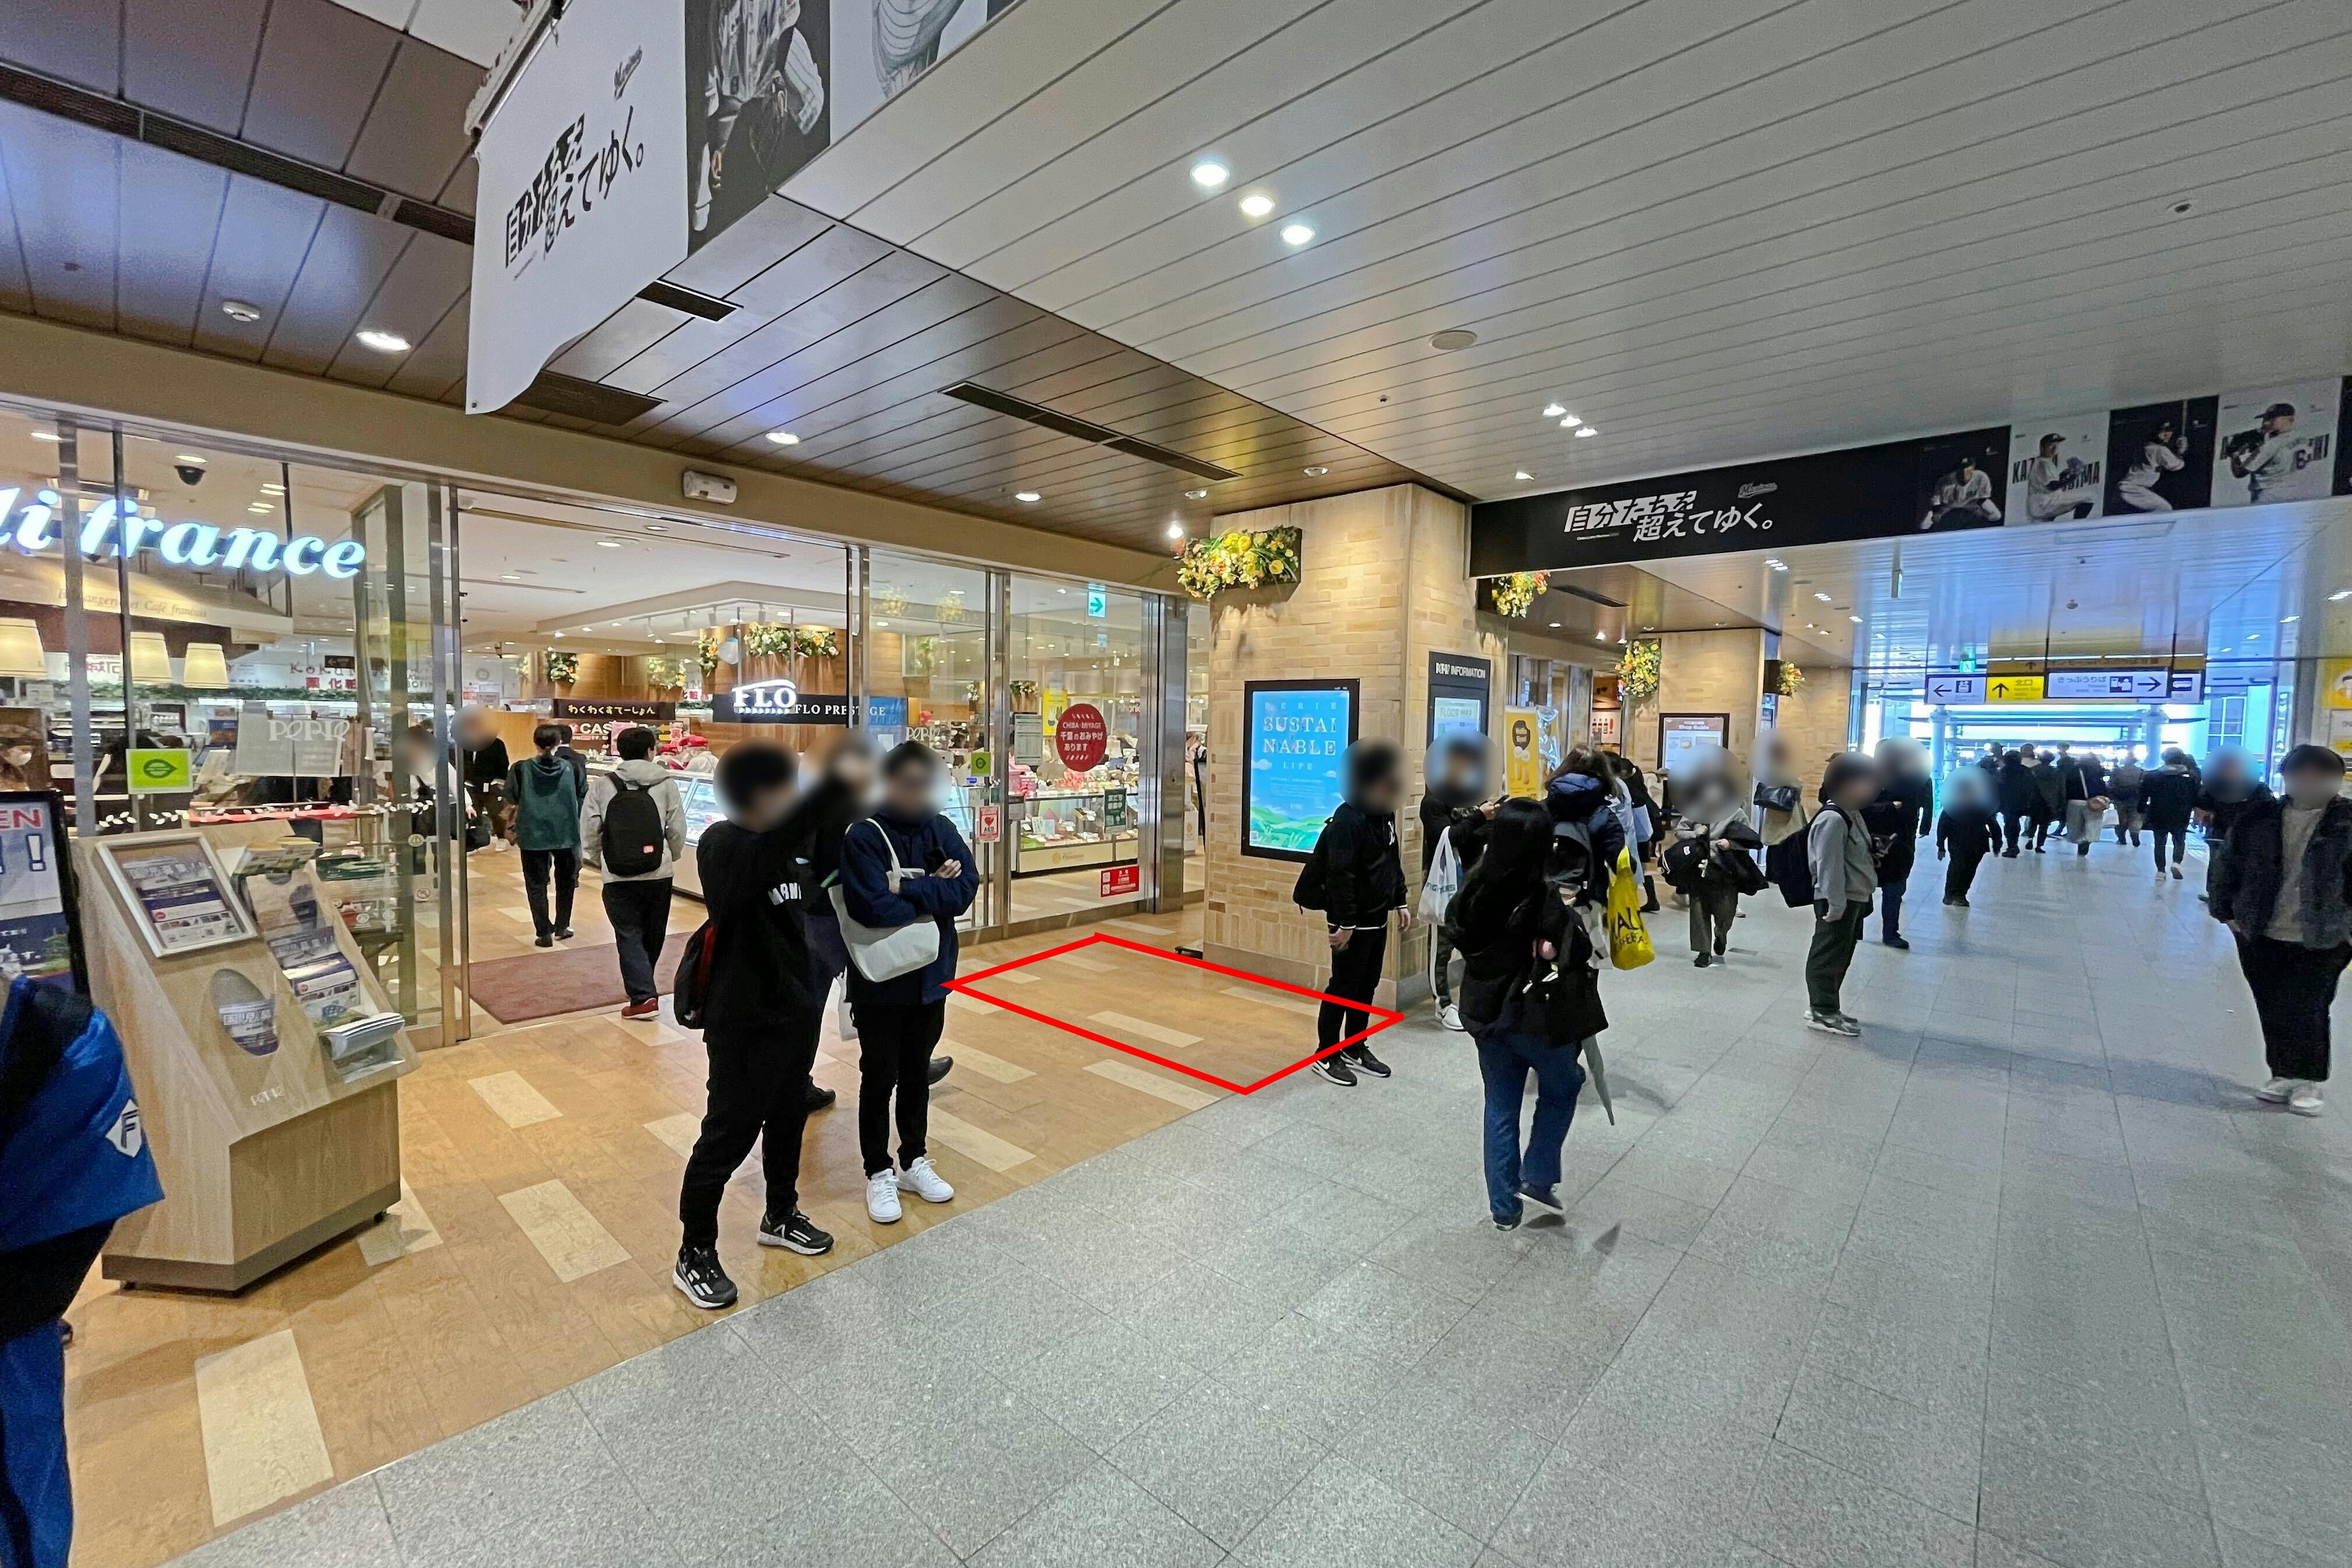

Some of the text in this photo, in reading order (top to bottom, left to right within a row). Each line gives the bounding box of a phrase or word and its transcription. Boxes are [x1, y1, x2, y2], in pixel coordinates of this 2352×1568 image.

[543, 105, 644, 261] 超えてゆく。
[1564, 491, 1698, 533] 自分たちを
[1633, 502, 1773, 542] 超えてゆく。
[1451, 664, 1486, 678] INFORMATION
[733, 684, 796, 708] FLO
[568, 704, 656, 716] わくわくすてーしょん
[796, 704, 820, 715] FLO
[825, 705, 886, 716] PRESTGE
[1263, 715, 1337, 733] SUSTAI
[1060, 731, 1104, 741] 千葉のおみやげ
[1064, 743, 1088, 751] あります
[1262, 738, 1336, 756] NABLE
[121, 1108, 139, 1149] F
